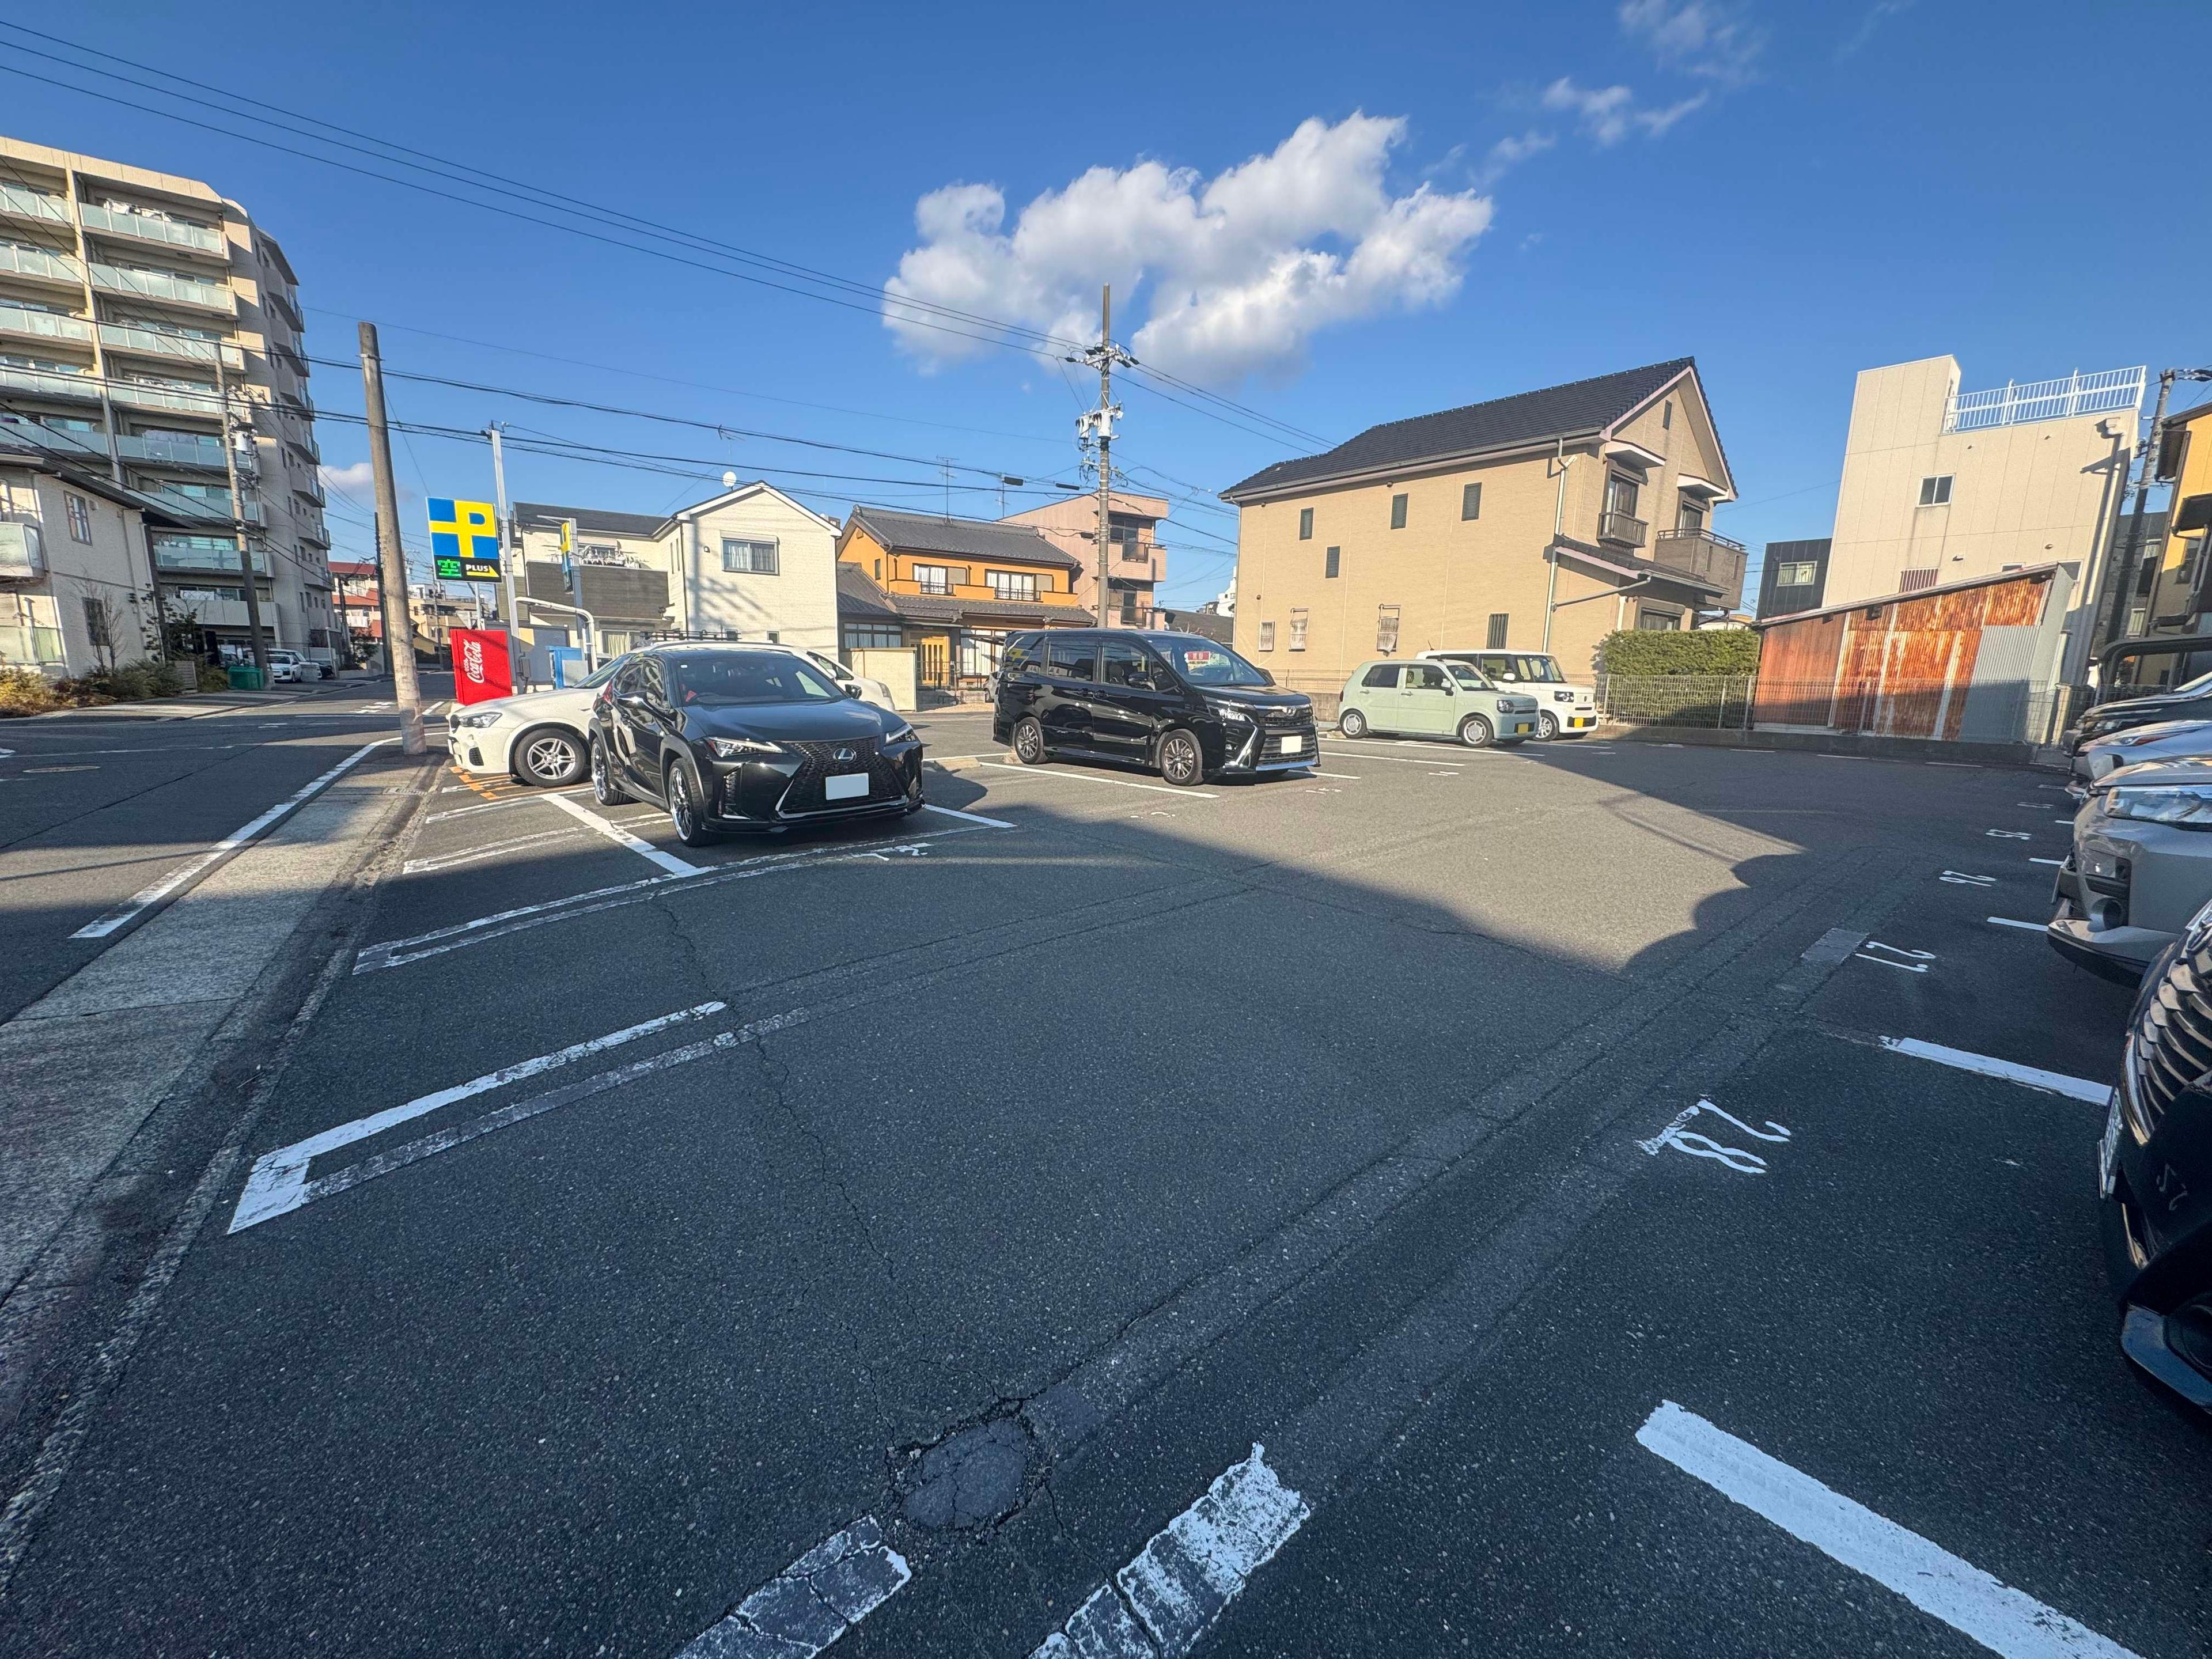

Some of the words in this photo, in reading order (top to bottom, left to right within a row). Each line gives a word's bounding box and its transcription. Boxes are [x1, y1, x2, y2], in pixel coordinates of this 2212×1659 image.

[437, 559, 462, 577] 空
[465, 564, 489, 572] PLUS
[1938, 870, 1997, 887] 26
[1855, 941, 1936, 973] 27
[1666, 1099, 1791, 1174] 28
